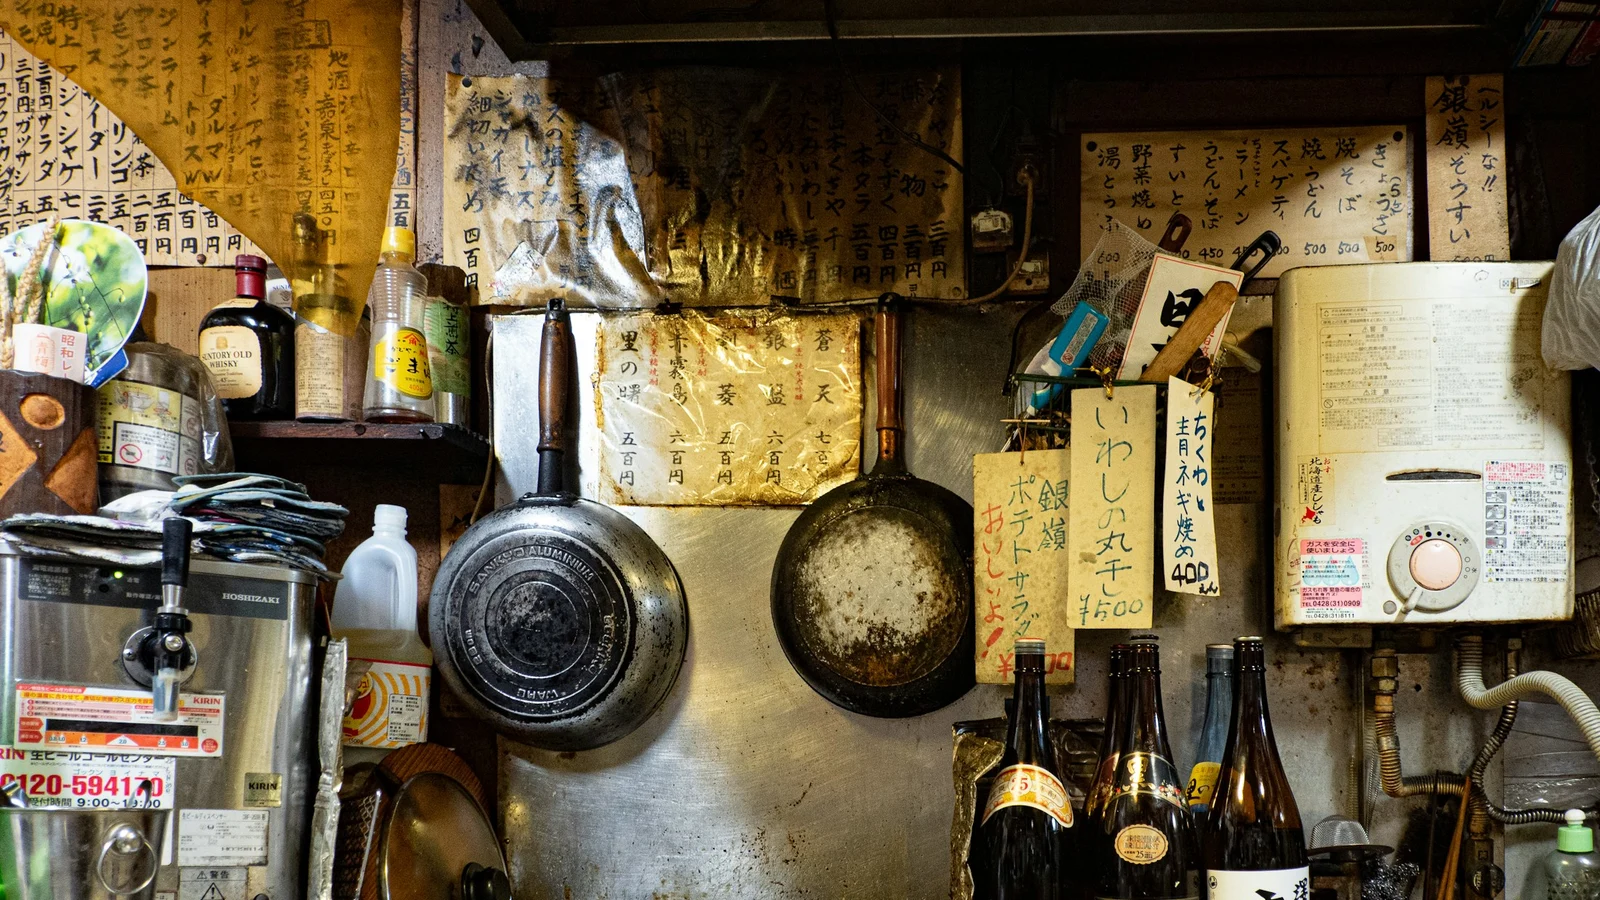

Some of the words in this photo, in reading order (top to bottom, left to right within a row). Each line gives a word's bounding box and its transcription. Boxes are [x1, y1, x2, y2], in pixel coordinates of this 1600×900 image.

[15, 58, 33, 112] 三百円
[35, 61, 53, 111] 三百円
[14, 115, 34, 187] ガツサシ
[35, 112, 58, 182] サラダ
[111, 121, 133, 185] リンゴ
[1270, 139, 1294, 221] スパゲティ
[1301, 138, 1326, 219] 焼うどん
[1335, 138, 1362, 214] 焼そば
[1371, 142, 1394, 236] ぎょうざ
[152, 191, 176, 254] 五百円
[927, 220, 950, 279] 三百円
[1304, 242, 1327, 256] 500
[1337, 241, 1360, 255] 500
[1374, 241, 1395, 253] 500
[463, 227, 480, 291] 四百円
[850, 223, 873, 284] 五百円
[876, 225, 899, 283] 四百円
[902, 224, 925, 279] 三百円
[1198, 247, 1224, 261] 450
[210, 360, 238, 368] WHISKY
[233, 350, 252, 359] OLD
[812, 328, 835, 404] 蒼天
[619, 431, 637, 487] 五百円
[669, 430, 688, 486] 六百円
[716, 430, 735, 486] 五百円
[765, 430, 784, 486] 六百円
[1192, 410, 1209, 513] ちくわと
[1095, 406, 1135, 598] いわしの丸干し
[1174, 416, 1198, 560] 青ネギ焼め
[1309, 456, 1324, 524] 北海道産ししゃも
[222, 592, 280, 604] HOSHIZAKI
[1171, 562, 1210, 588] 400
[1078, 593, 1143, 627] ¥500
[193, 697, 221, 705] KIRIN
[249, 782, 278, 791] KIRIN
